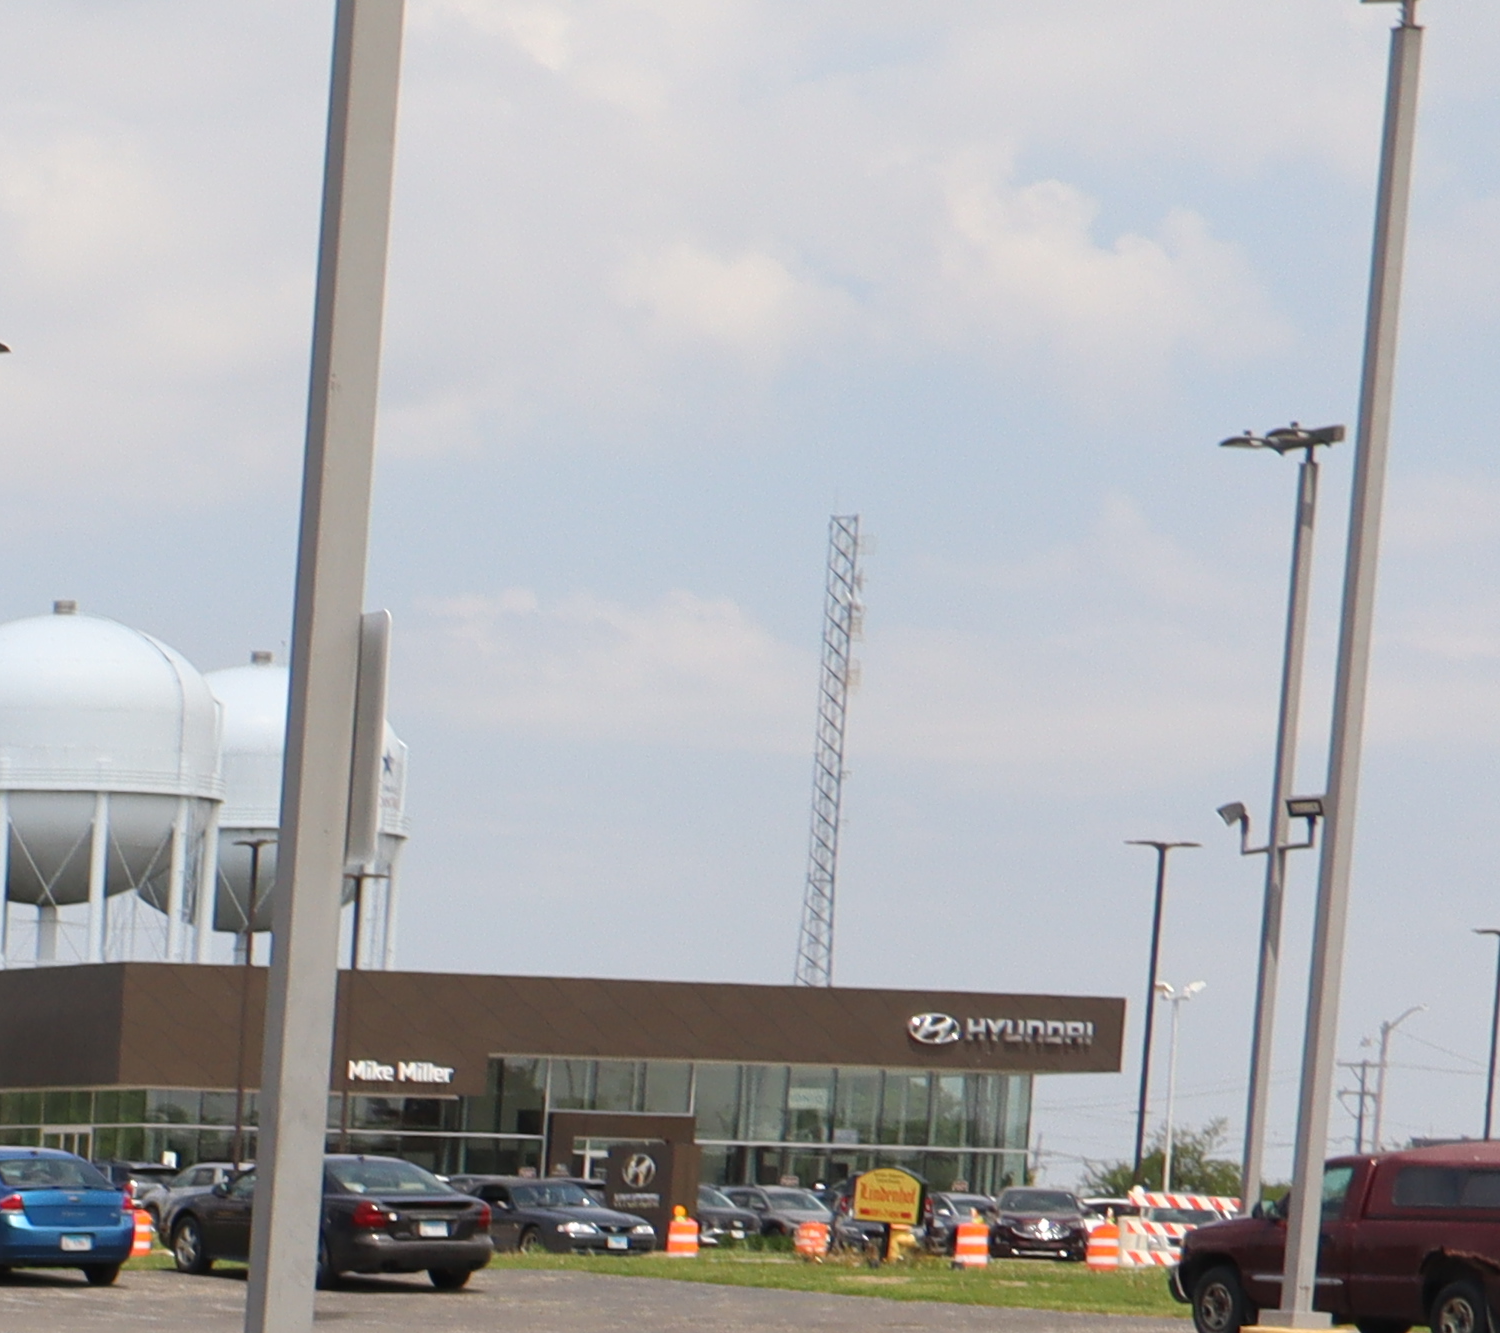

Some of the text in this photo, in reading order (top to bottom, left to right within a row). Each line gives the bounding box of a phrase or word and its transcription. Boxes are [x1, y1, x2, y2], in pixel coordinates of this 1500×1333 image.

[966, 1017, 1095, 1045] HYUNDAI
[347, 1059, 455, 1083] Mike Miller
